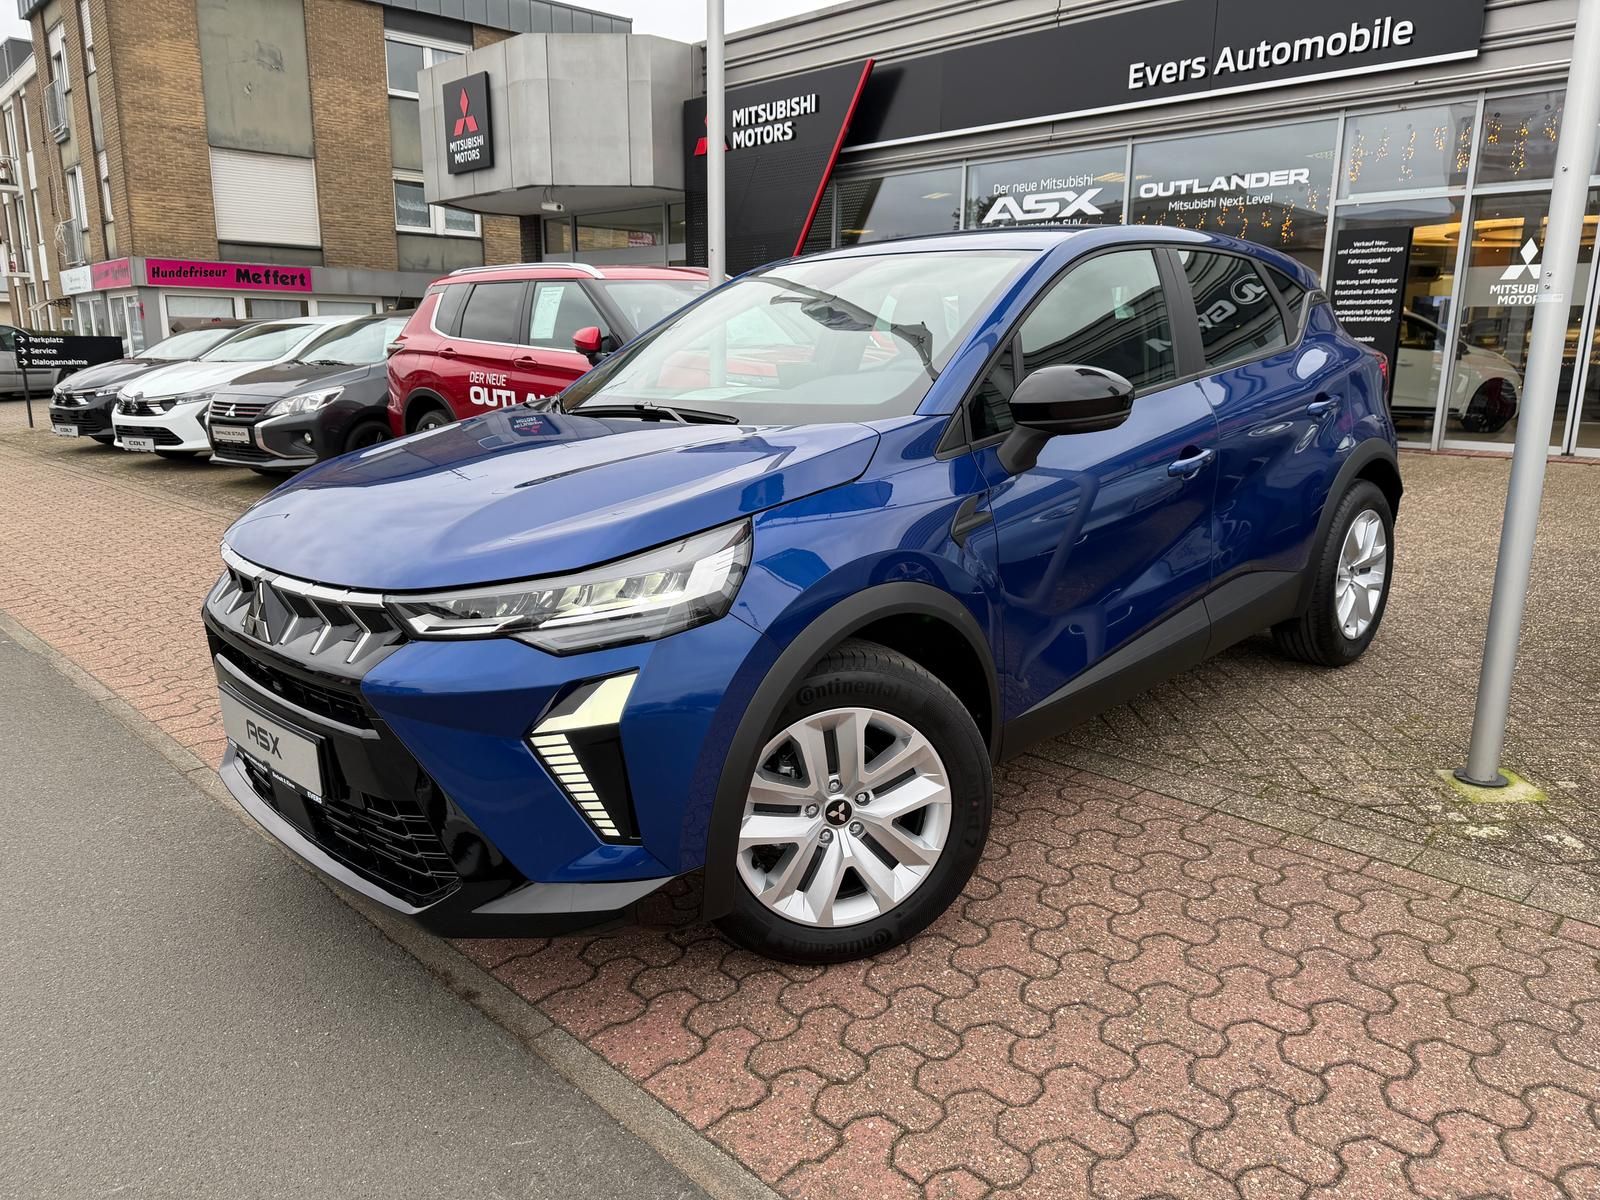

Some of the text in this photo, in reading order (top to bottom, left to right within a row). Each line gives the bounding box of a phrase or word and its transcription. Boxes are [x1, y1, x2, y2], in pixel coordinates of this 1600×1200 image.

[1128, 16, 1414, 89] Evers Automobile
[732, 93, 816, 128] MITSUBISHI
[450, 134, 484, 152] MITSUBISHI
[732, 121, 793, 149] MOTORS
[454, 149, 480, 164] MOTORS
[993, 173, 1094, 195] Der neue Mitsubishi
[1139, 167, 1310, 198] OUTLANDER
[981, 187, 1104, 224] ASX
[1168, 193, 1273, 211] Mitsubishi Next Level
[1347, 256, 1391, 265] Fahrzeugankauf
[151, 266, 306, 287] Hundefriseur Meffert
[1489, 284, 1539, 295] MITSUBI
[28, 336, 64, 344] Parkplatz
[31, 359, 88, 367] Dialogannahme
[469, 371, 507, 387] DER NEUE
[799, 677, 902, 705] Continental
[246, 719, 283, 760] ASX
